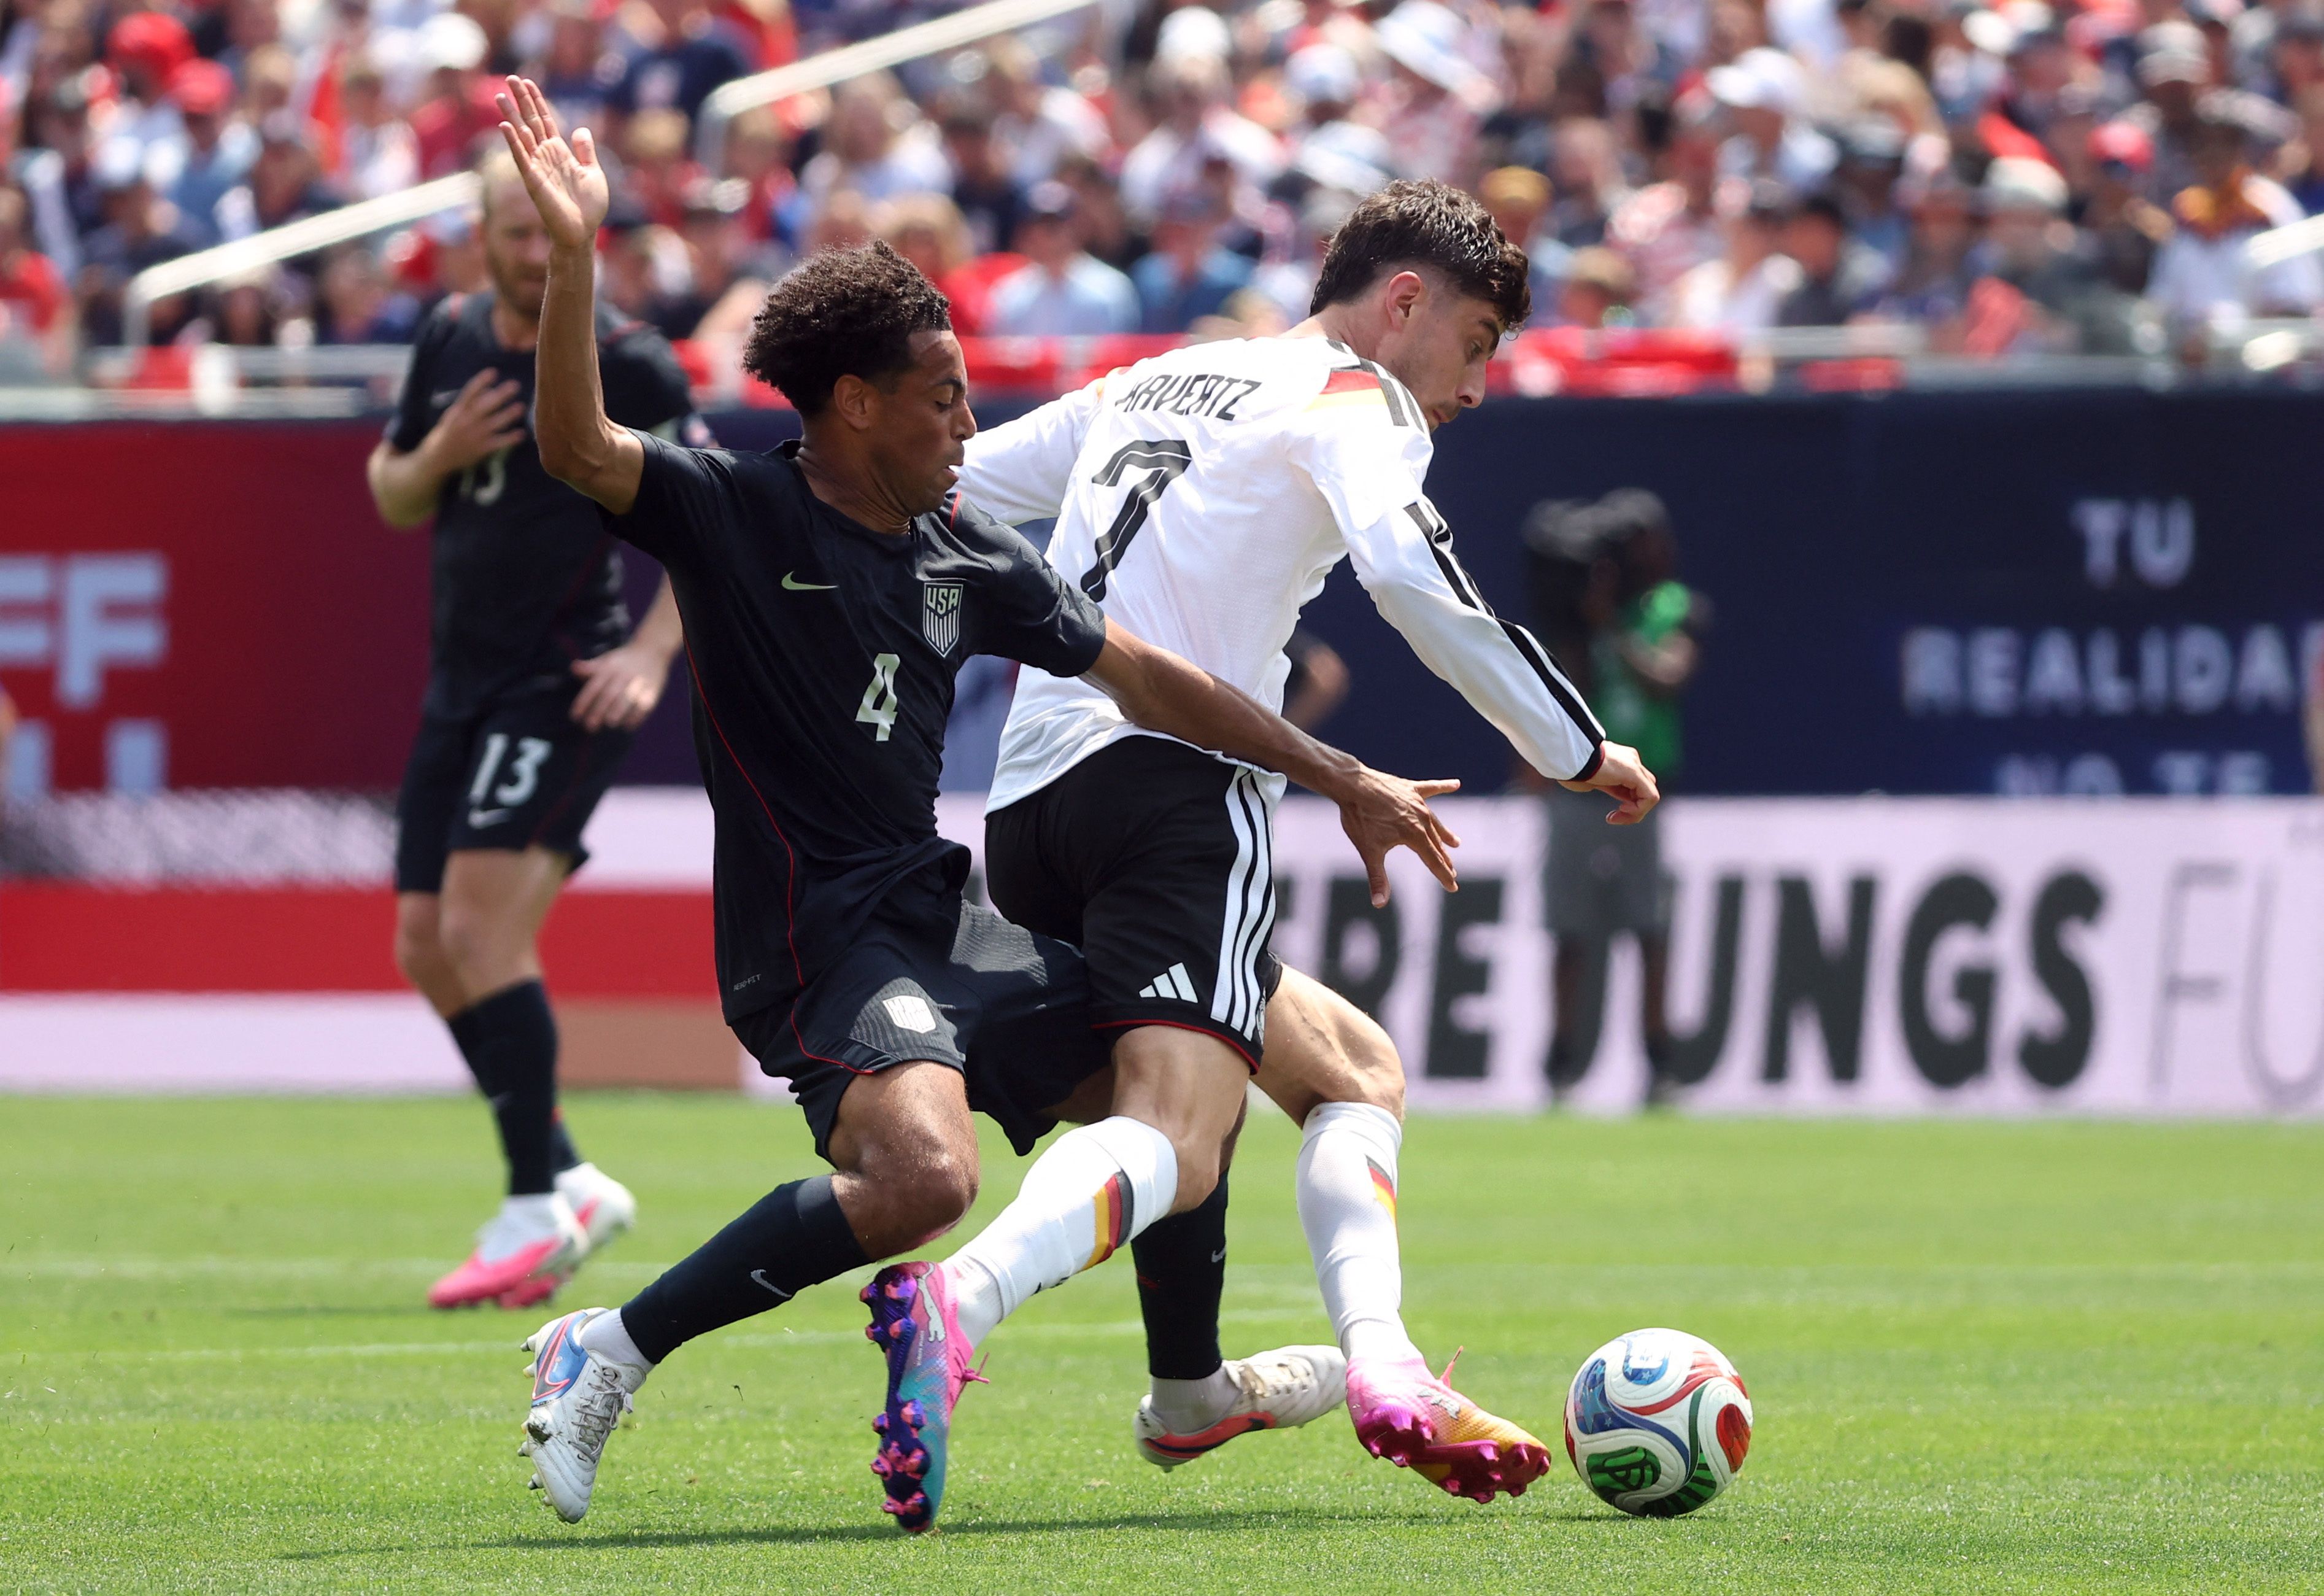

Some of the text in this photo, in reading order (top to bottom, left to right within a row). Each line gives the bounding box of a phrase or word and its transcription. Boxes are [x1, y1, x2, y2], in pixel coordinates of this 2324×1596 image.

[1081, 440, 1192, 602] 7
[2073, 498, 2195, 586] TU
[927, 587, 959, 614] USA
[855, 653, 900, 741] 4
[468, 734, 552, 807] 13
